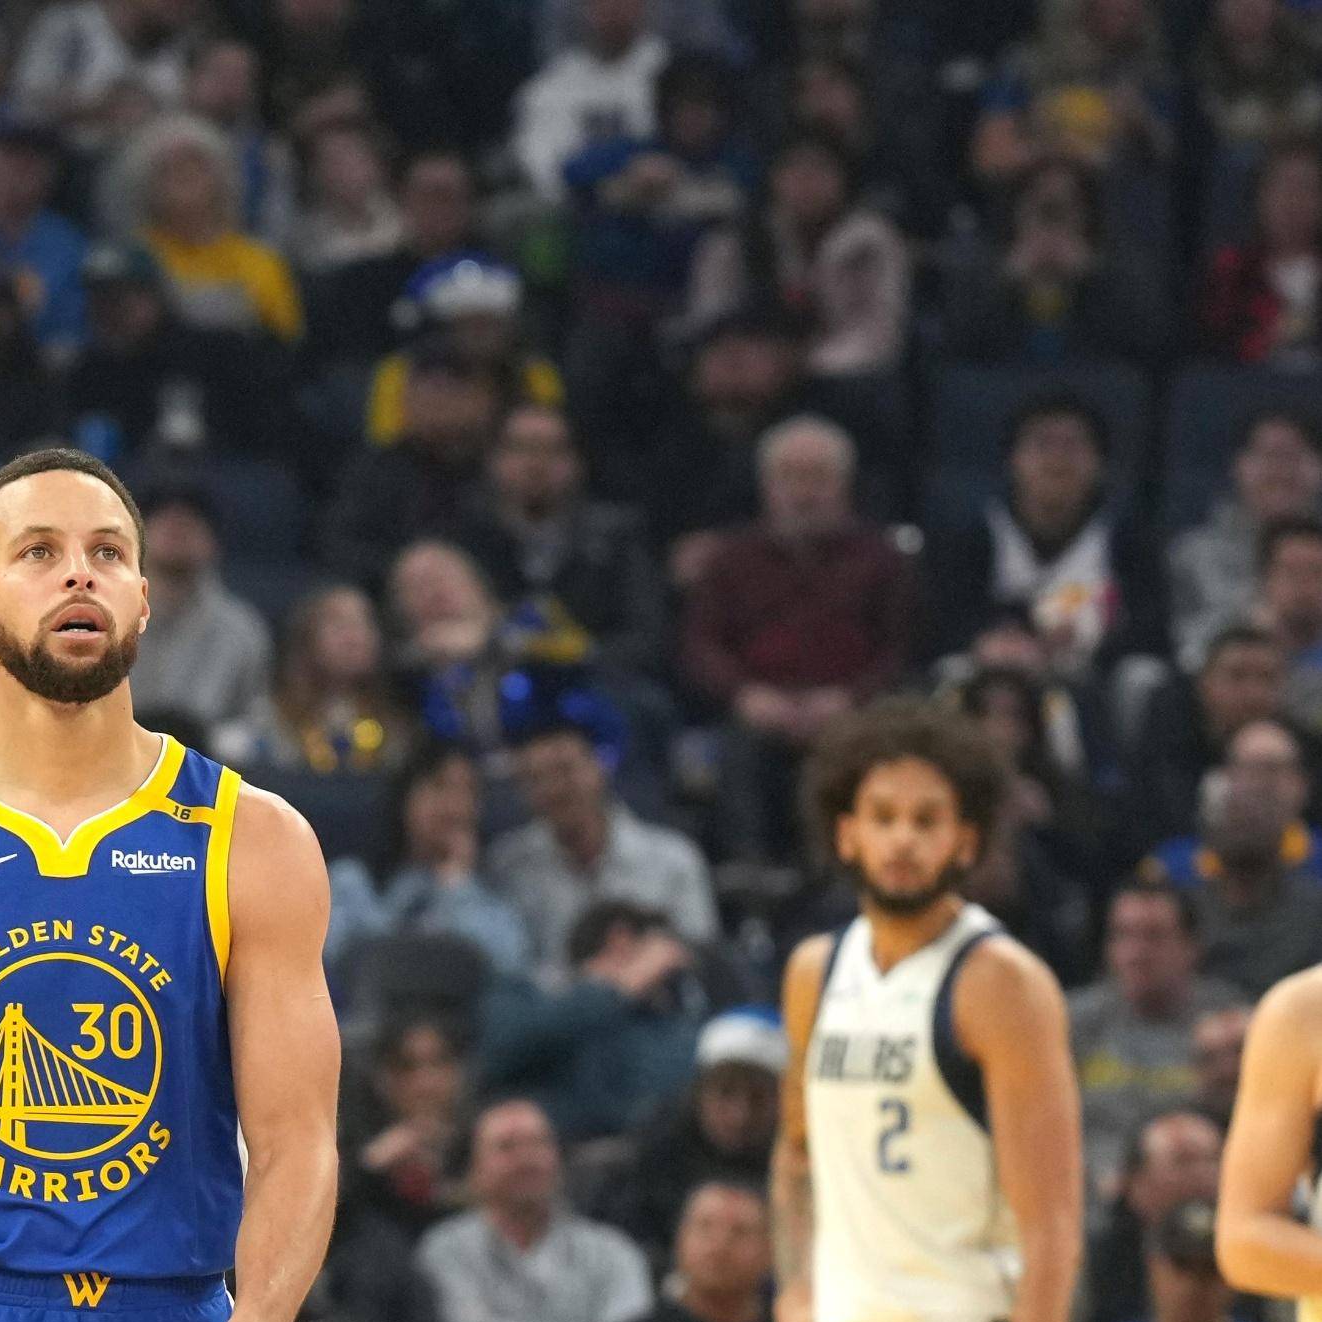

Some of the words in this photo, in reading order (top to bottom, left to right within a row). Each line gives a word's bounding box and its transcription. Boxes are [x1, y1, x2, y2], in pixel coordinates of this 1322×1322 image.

[173, 805, 191, 820] 16
[111, 849, 196, 873] Rakuten
[88, 925, 172, 991] STATE
[71, 1003, 142, 1060] 30
[877, 1098, 912, 1174] 2
[62, 1271, 111, 1308] W
